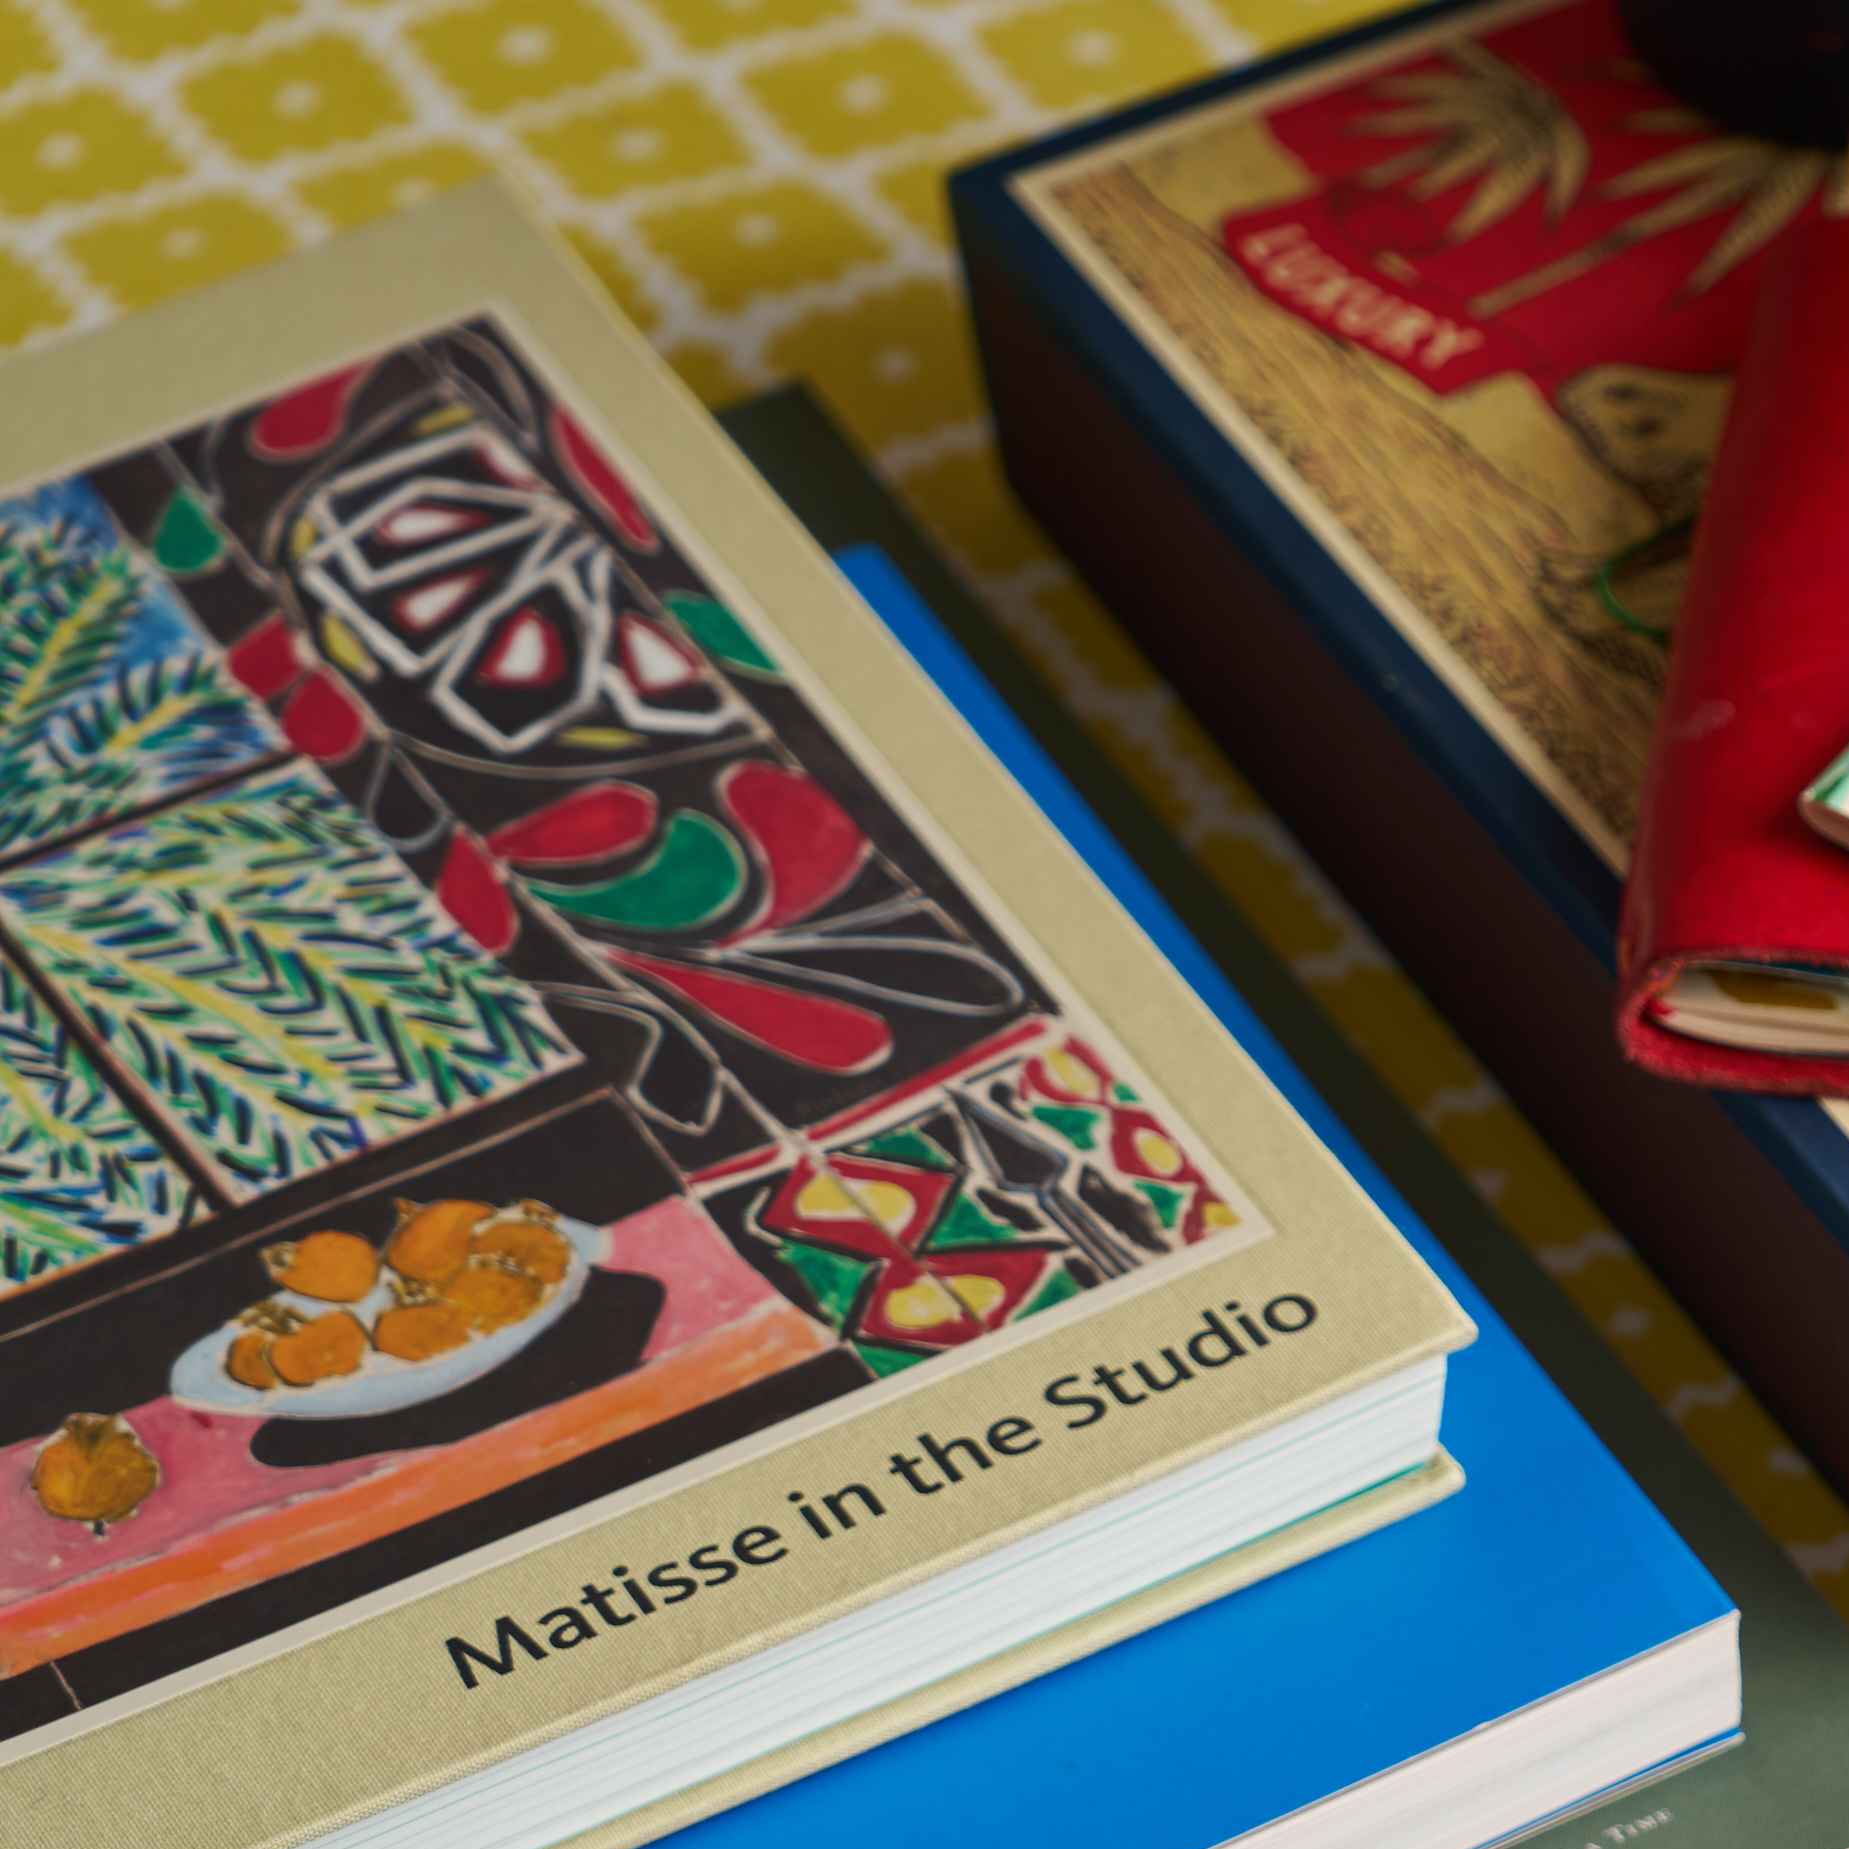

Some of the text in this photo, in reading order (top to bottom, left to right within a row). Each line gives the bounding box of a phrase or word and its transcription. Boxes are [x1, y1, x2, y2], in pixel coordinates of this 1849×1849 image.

[1241, 223, 1486, 369] LUXURY
[445, 1290, 1320, 1691] Matisse in the Studio
